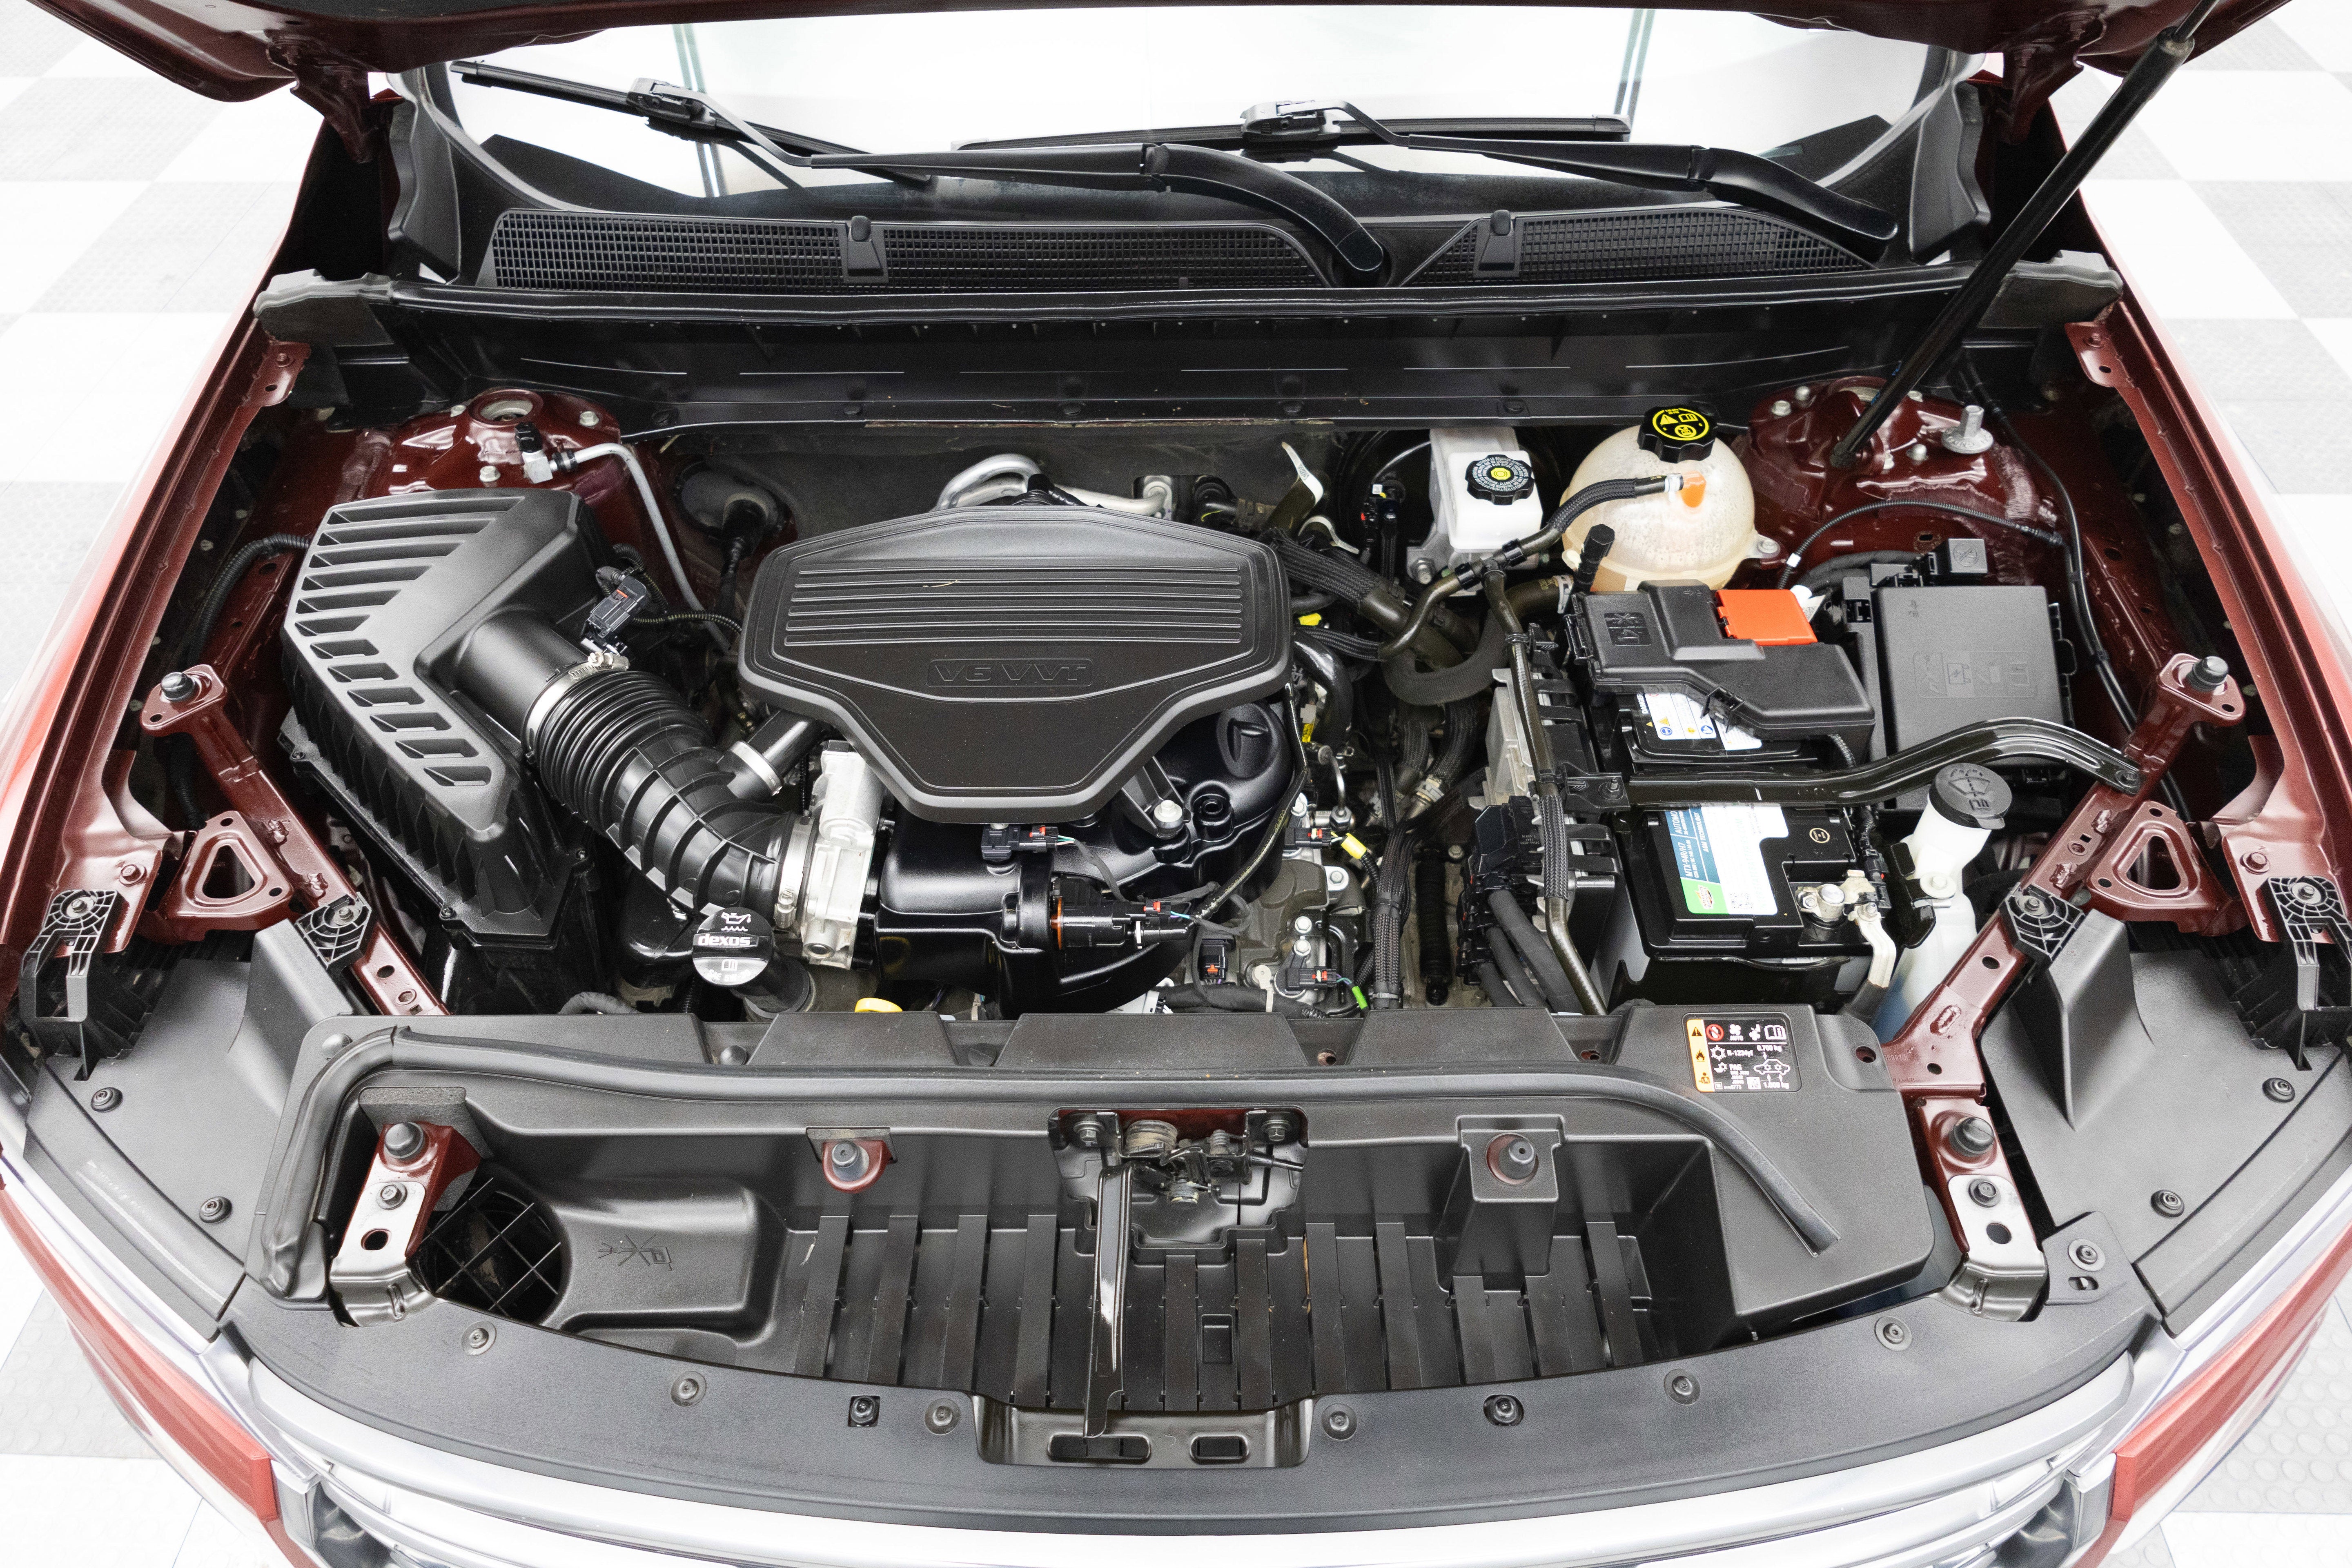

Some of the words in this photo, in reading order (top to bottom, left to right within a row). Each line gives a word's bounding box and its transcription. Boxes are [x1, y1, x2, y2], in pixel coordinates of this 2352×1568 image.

[935, 664, 992, 682] V6
[1001, 664, 1087, 681] VVT
[1693, 812, 1706, 841] TECHNOLOGY
[1701, 841, 1709, 853] AGM
[1678, 842, 1693, 877] MTX-94R/H7
[698, 933, 751, 946] dexos
